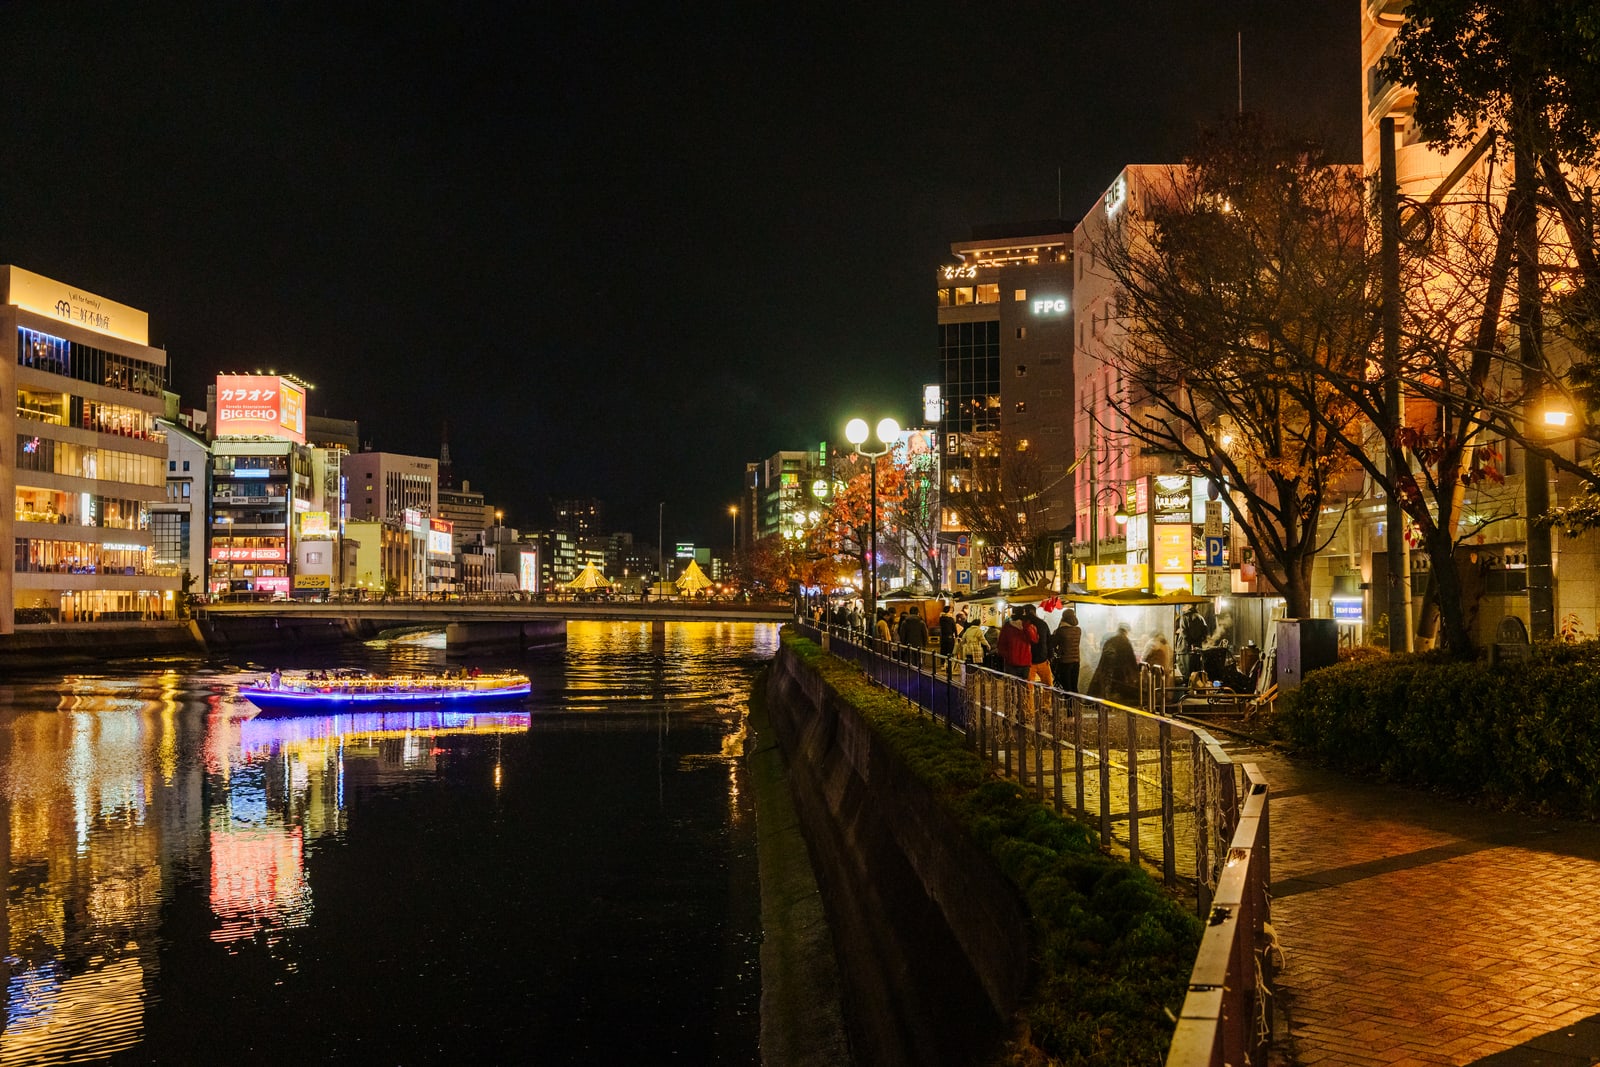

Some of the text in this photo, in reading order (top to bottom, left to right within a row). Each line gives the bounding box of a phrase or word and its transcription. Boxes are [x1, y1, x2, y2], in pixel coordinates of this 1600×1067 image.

[944, 264, 977, 279] なだ万
[1033, 300, 1066, 313] FPG
[221, 389, 276, 401] カラオケ
[220, 409, 277, 420] BIG ECHO
[1209, 539, 1220, 564] P
[959, 571, 968, 583] P
